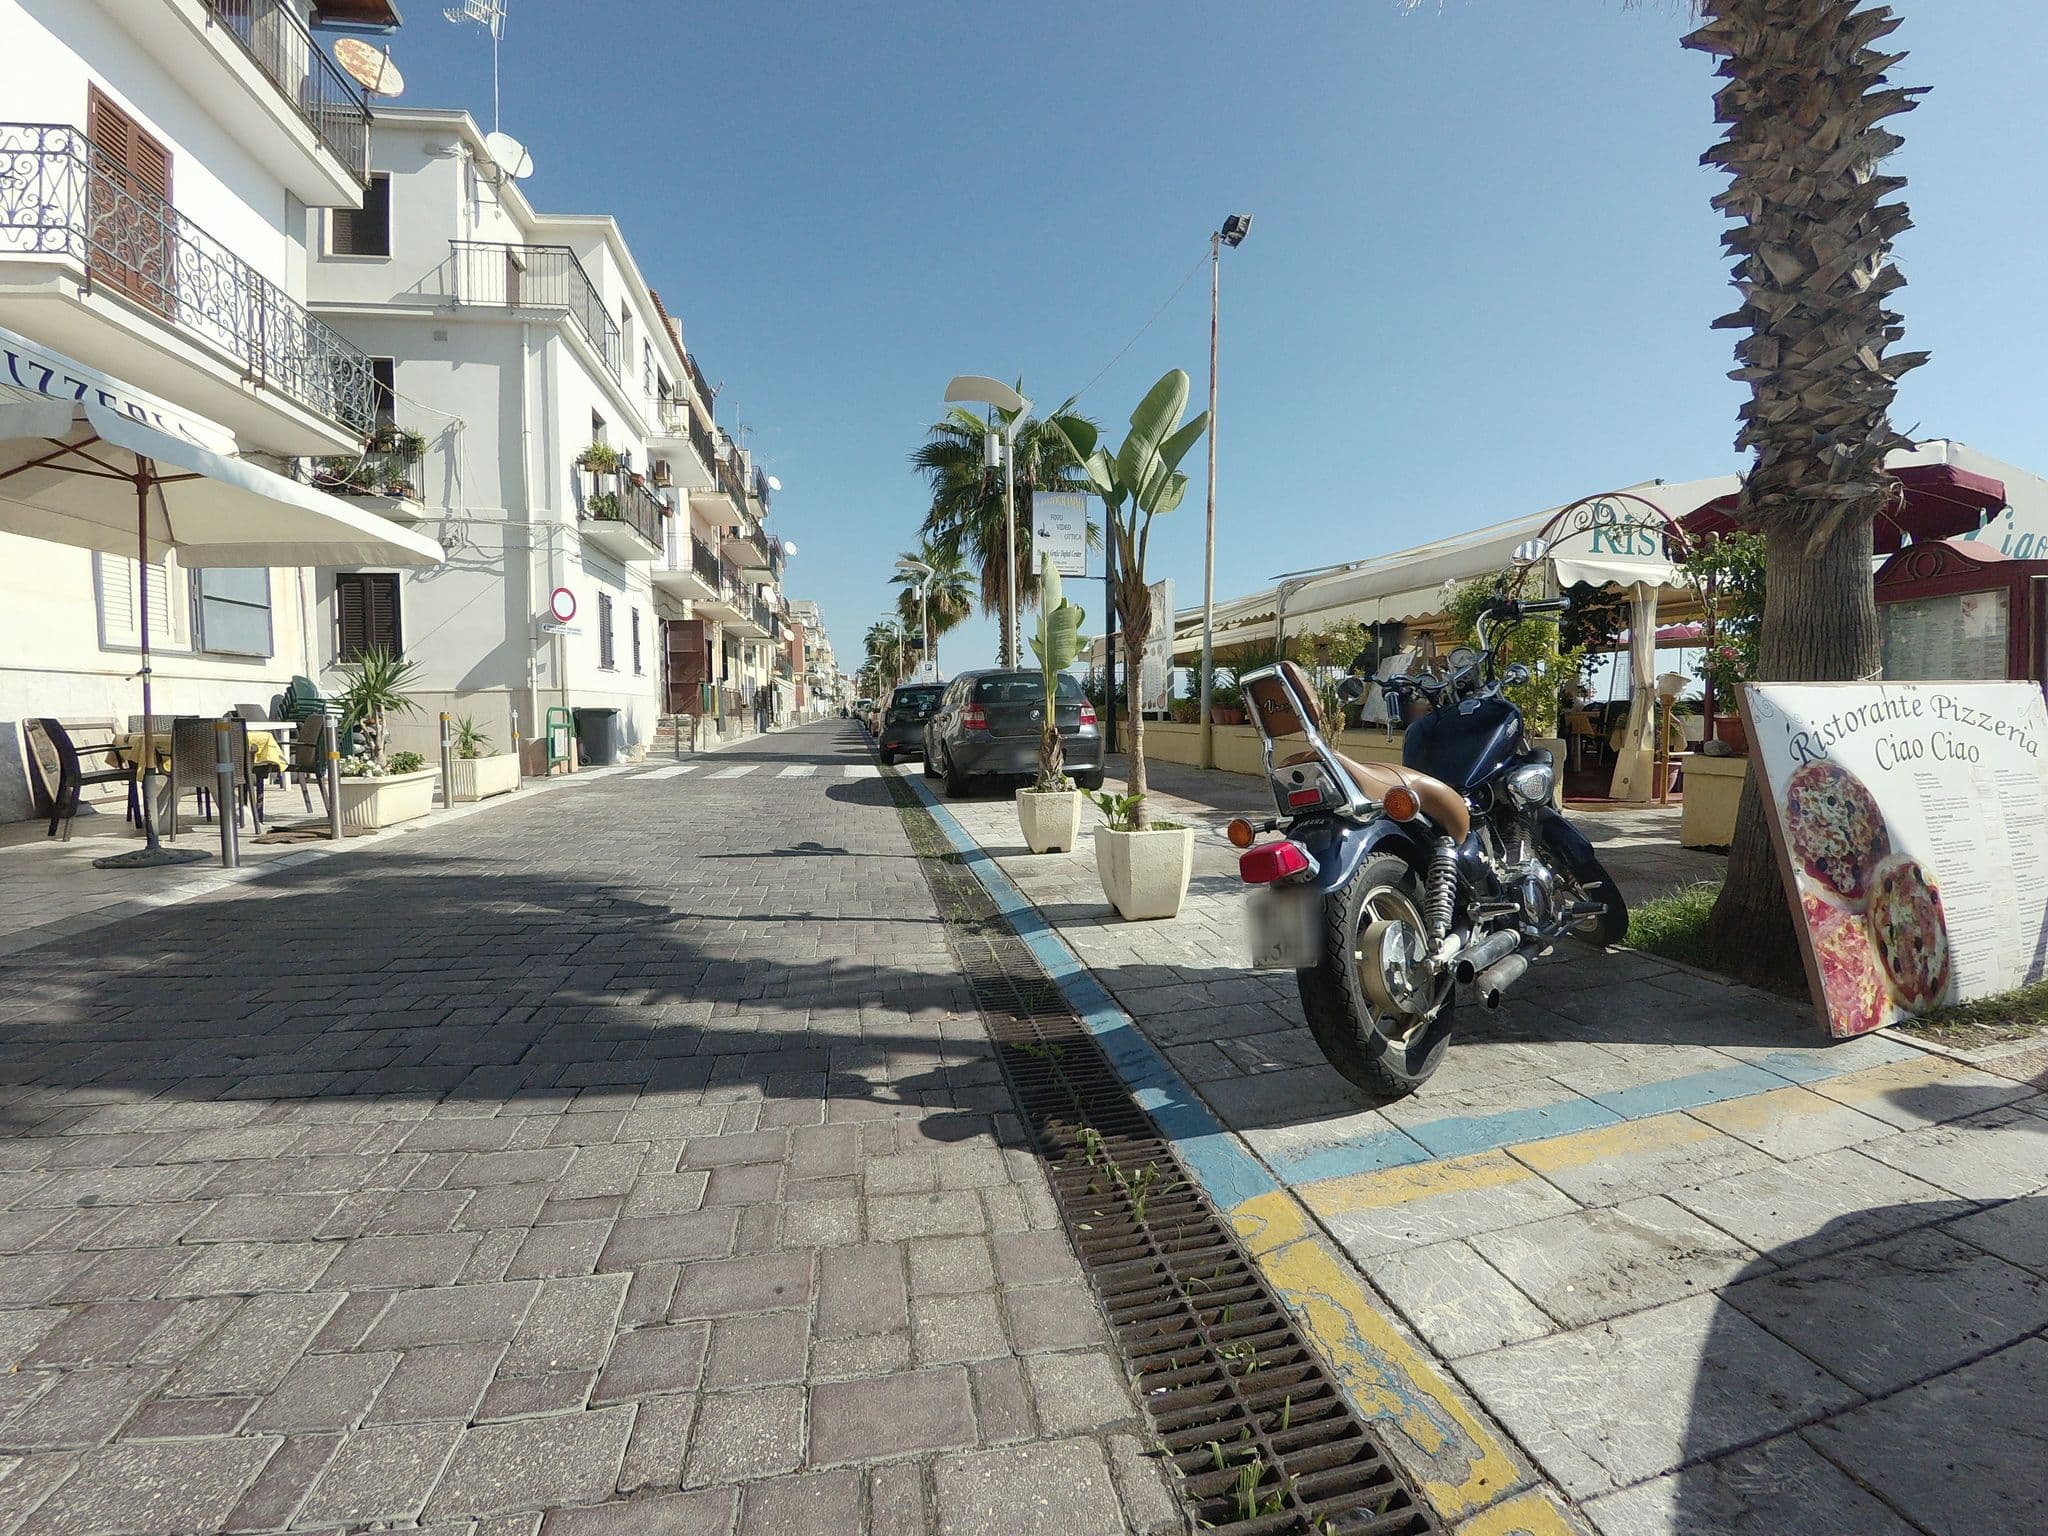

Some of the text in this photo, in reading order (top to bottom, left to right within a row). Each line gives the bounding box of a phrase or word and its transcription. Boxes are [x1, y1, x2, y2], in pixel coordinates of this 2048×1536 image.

[1789, 694, 2039, 768] Ristorante Pizzeria
[1875, 731, 1980, 771] Ciao Ciao
